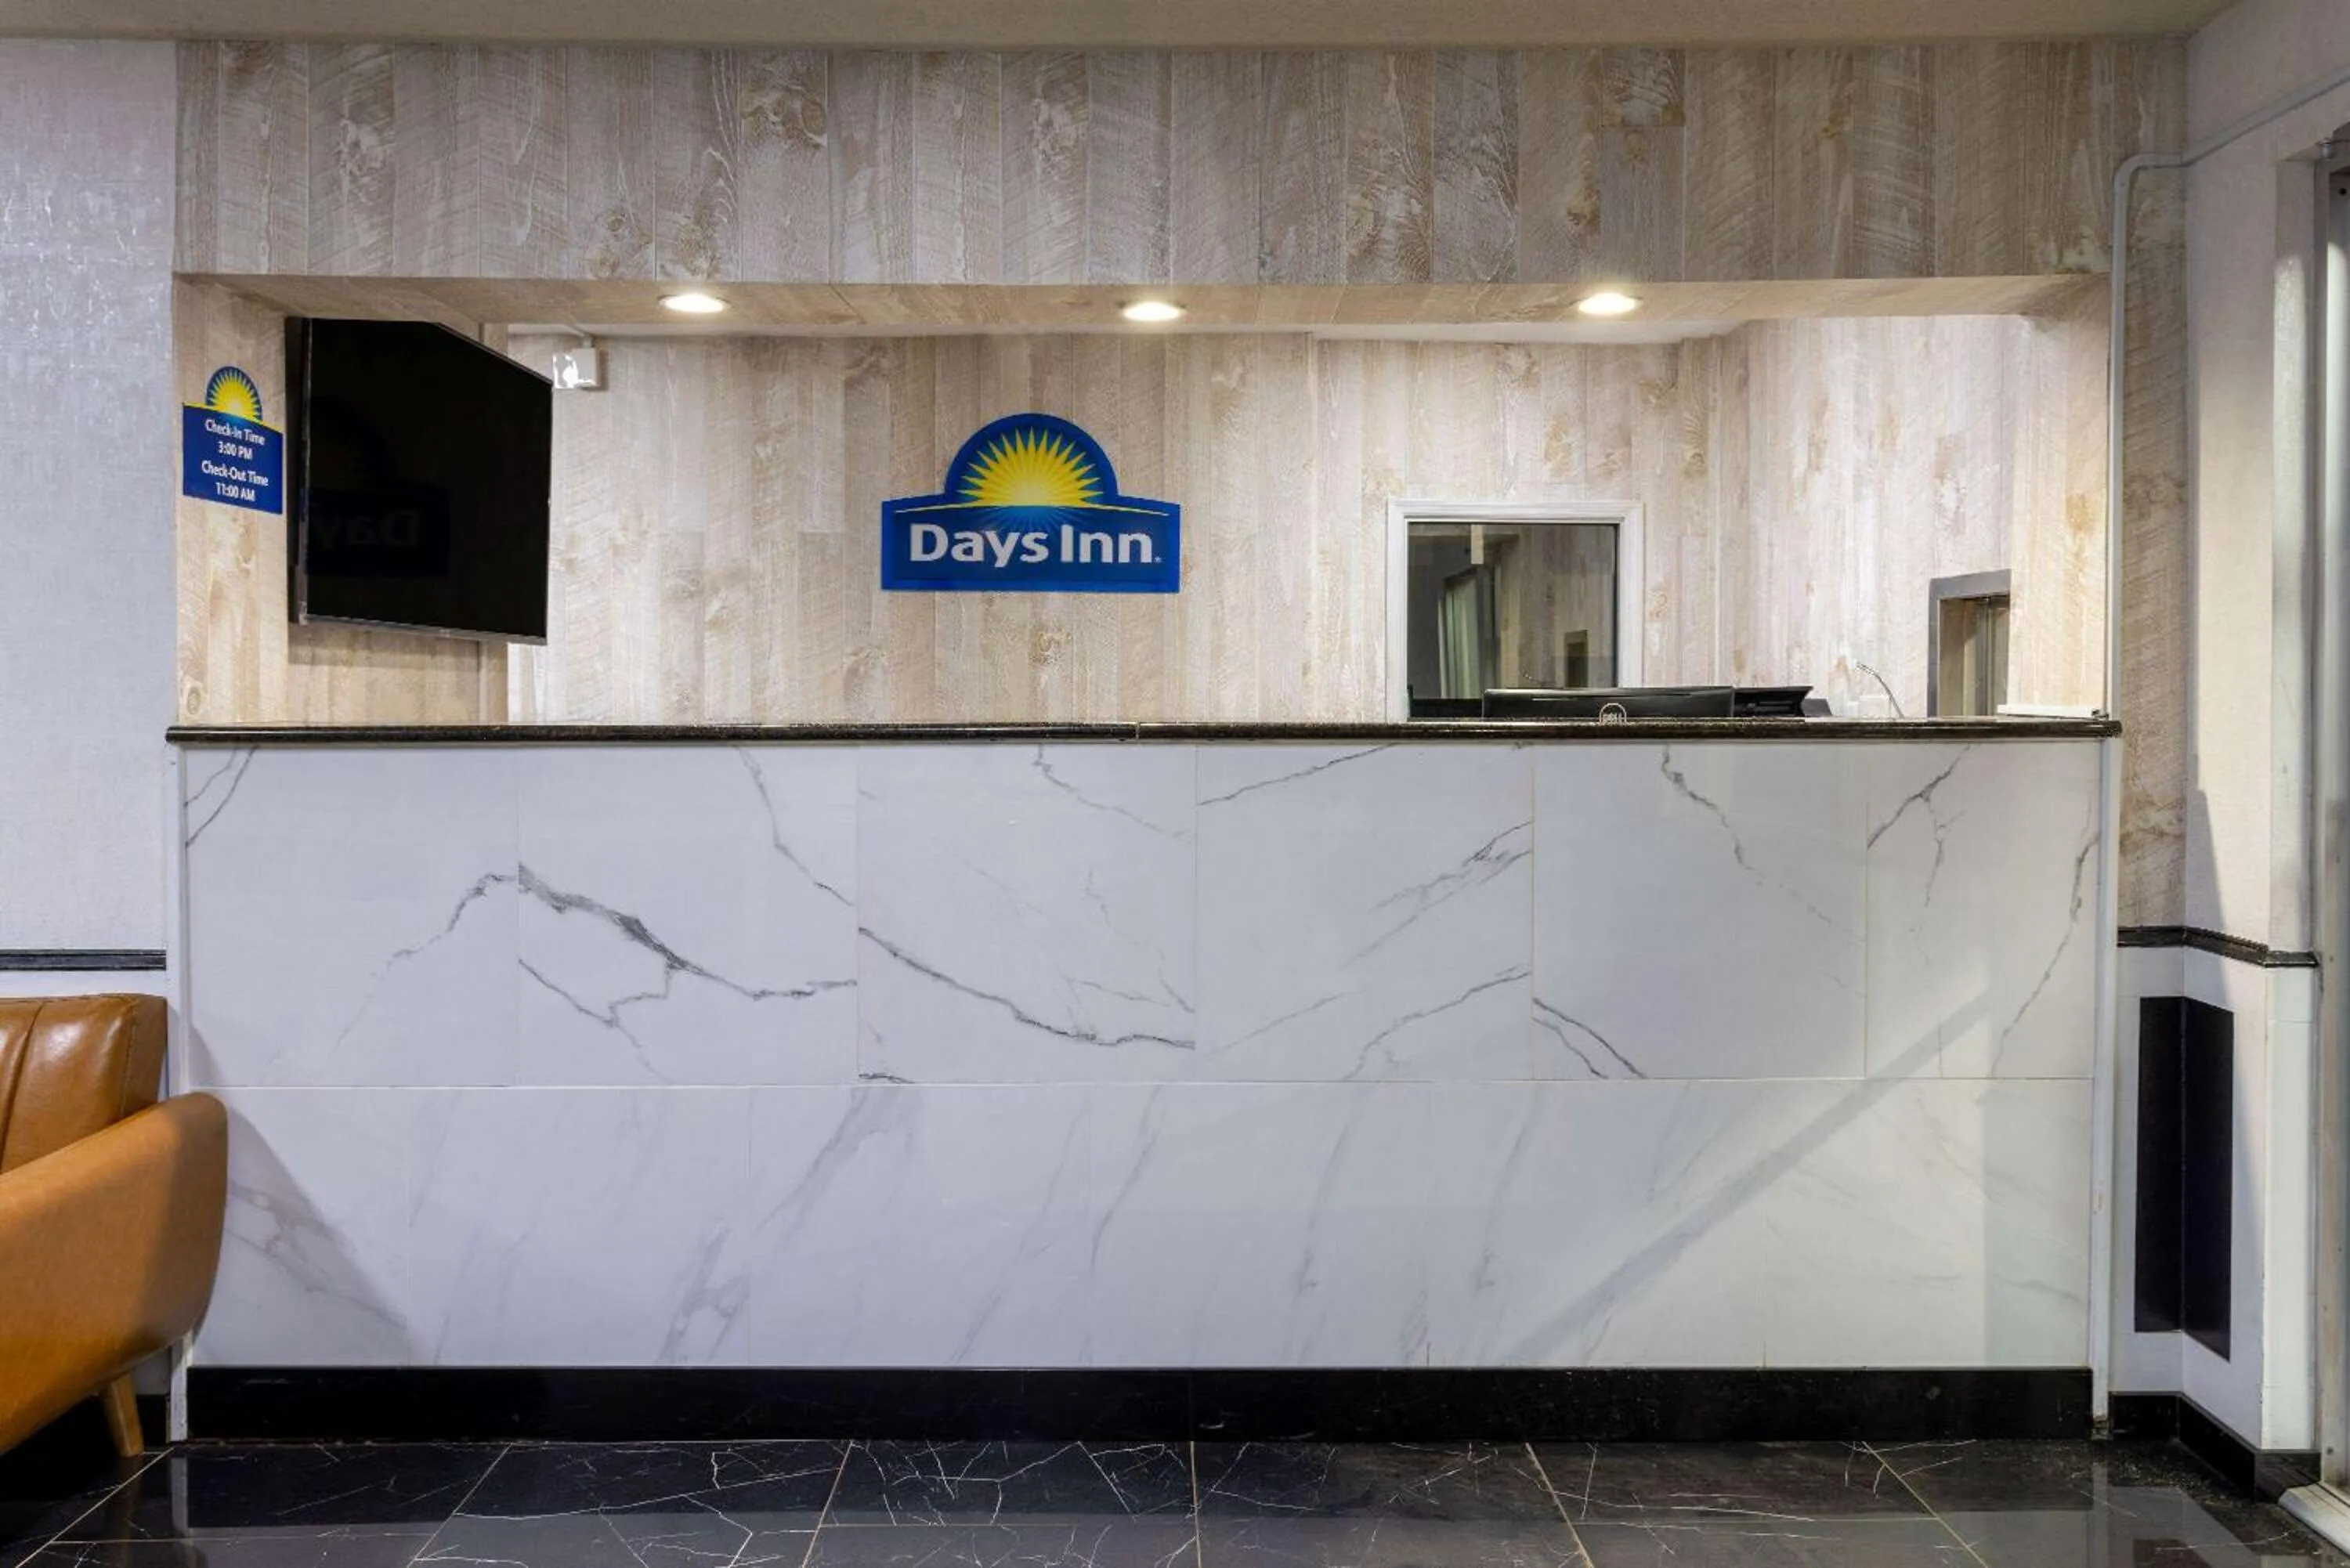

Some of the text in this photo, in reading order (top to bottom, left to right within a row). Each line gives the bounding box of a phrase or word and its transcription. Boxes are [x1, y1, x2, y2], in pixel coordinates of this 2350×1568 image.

[204, 419, 266, 446] Check-In Time
[218, 441, 253, 460] 3:00 PM
[201, 460, 269, 486] Check-Out Time
[215, 482, 255, 501] 11:00 AM
[909, 522, 1153, 568] Days Inn
